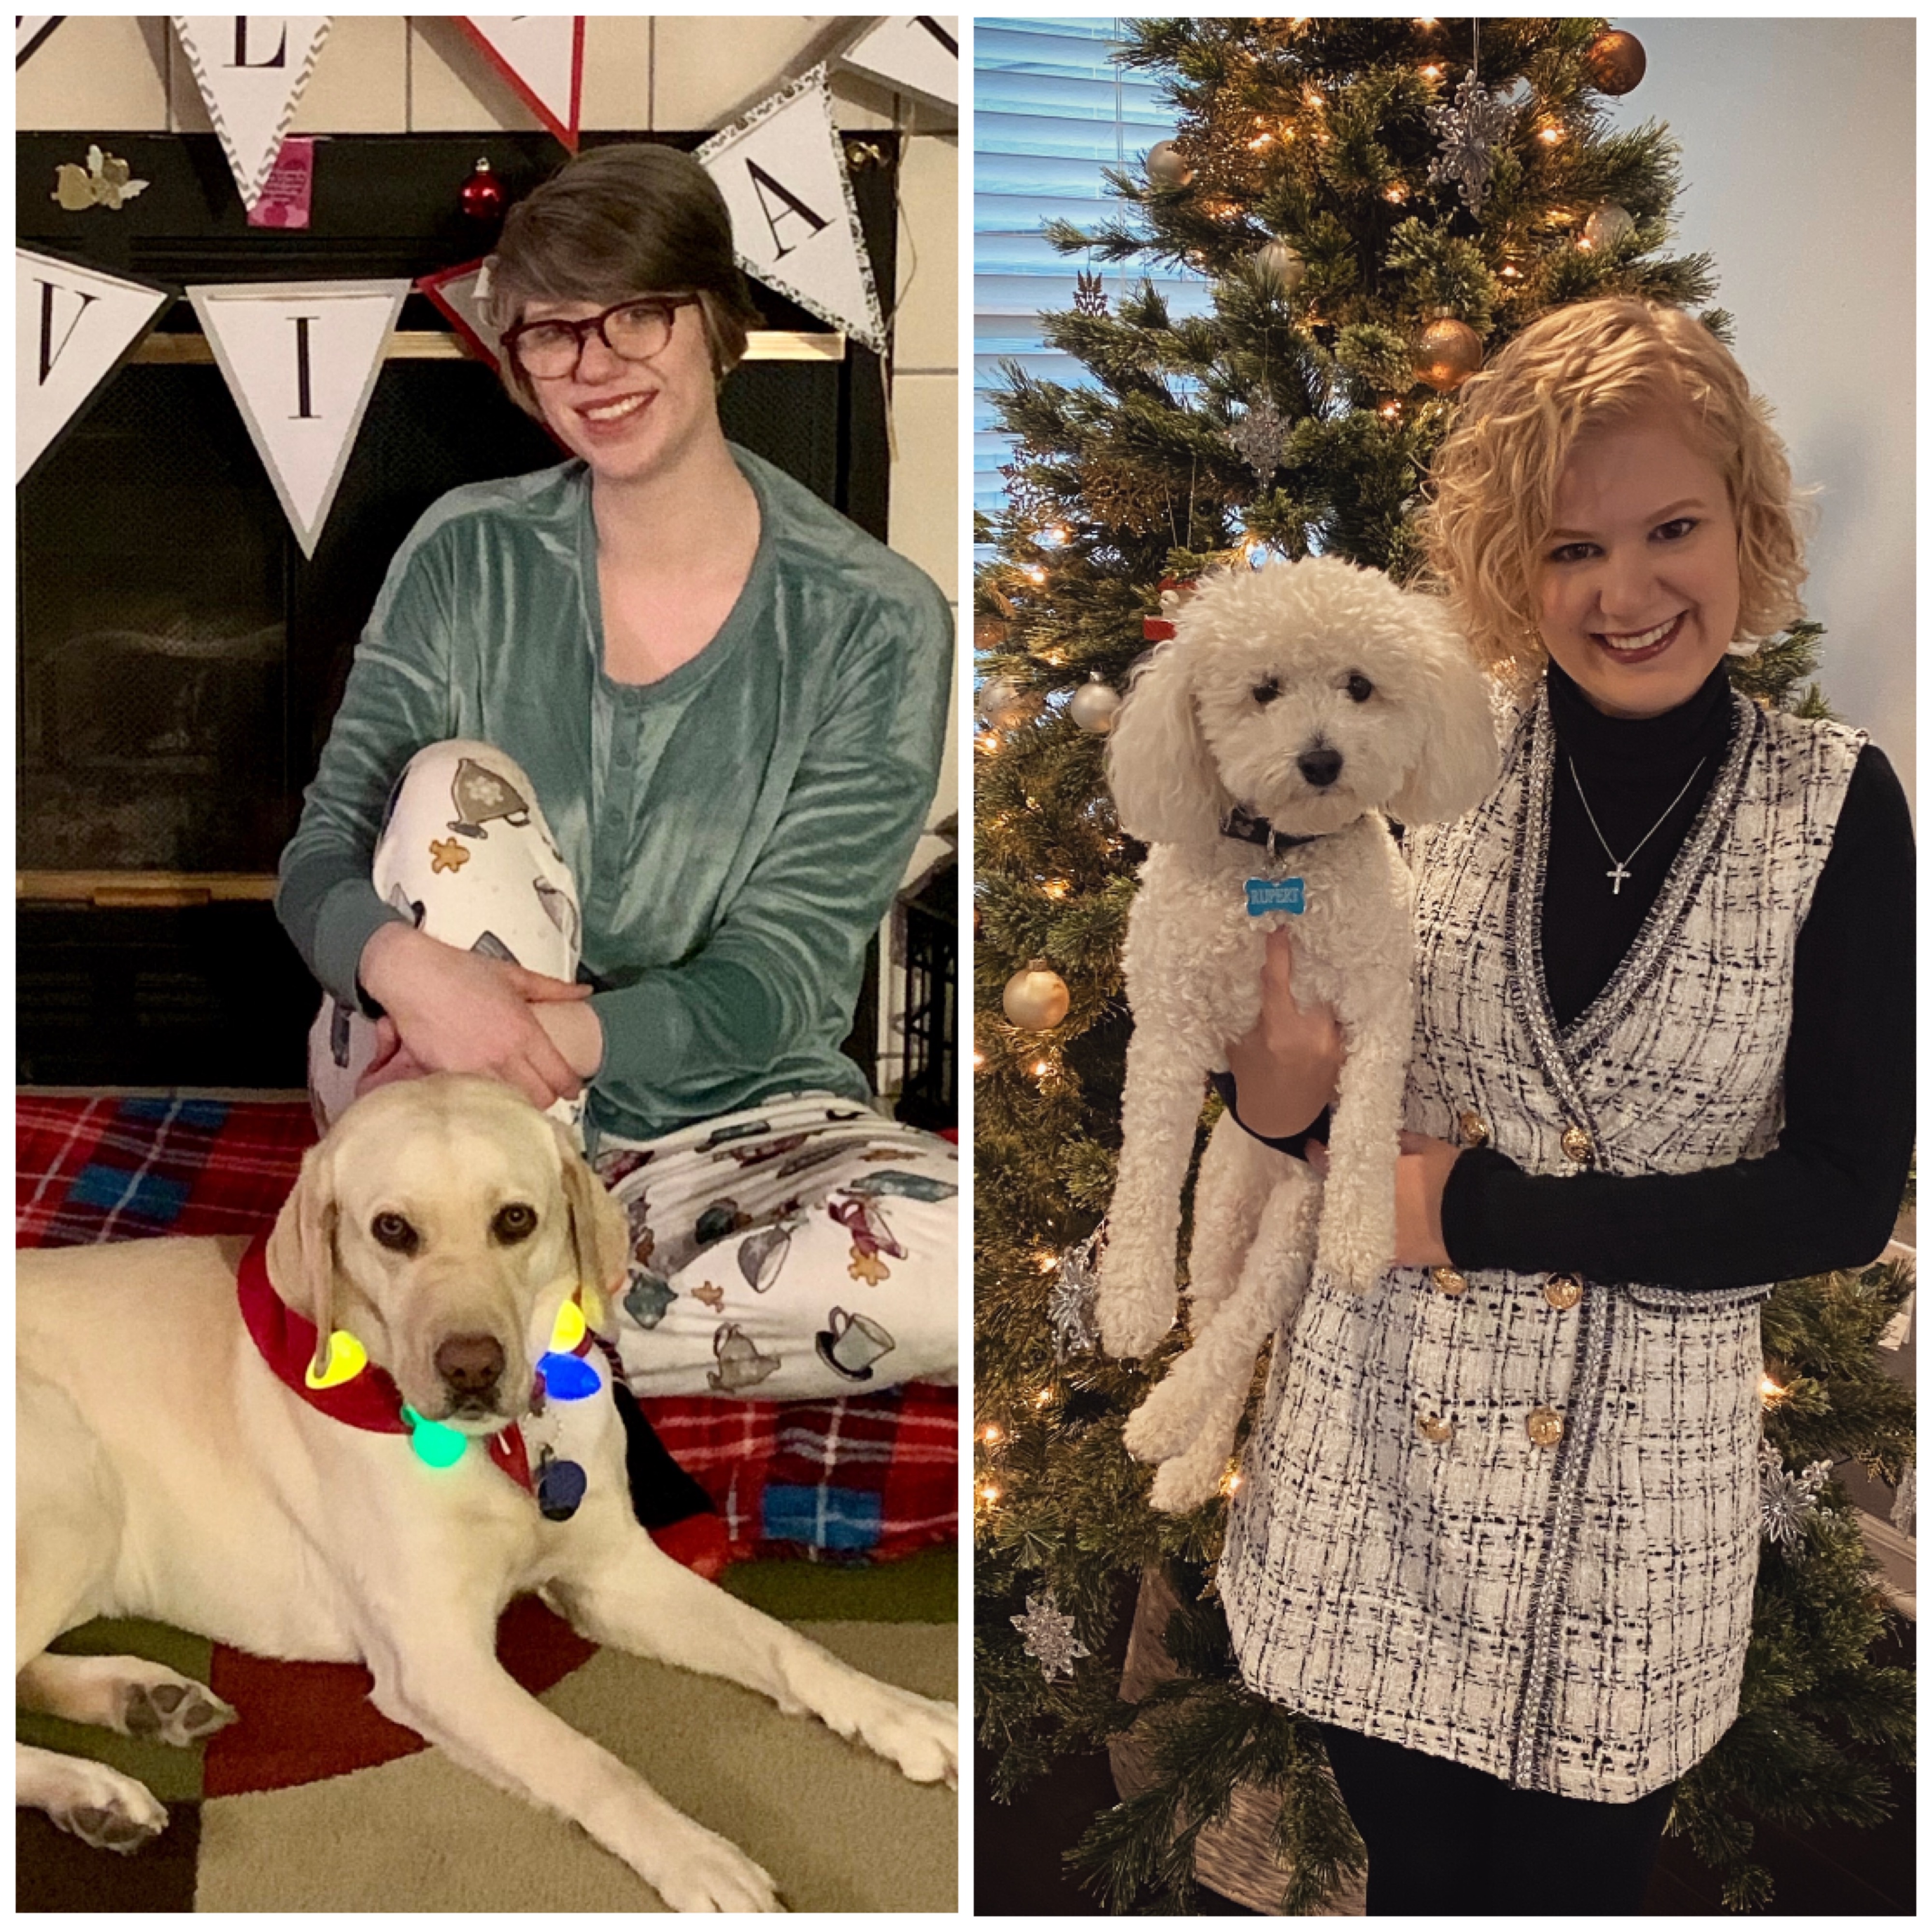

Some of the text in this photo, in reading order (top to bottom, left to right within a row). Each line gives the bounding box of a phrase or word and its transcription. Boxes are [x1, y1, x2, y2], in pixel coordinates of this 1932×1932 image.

[222, 16, 287, 68] L
[745, 157, 837, 262] A
[33, 277, 100, 386] V
[286, 316, 322, 419] I
[1250, 887, 1299, 904] RUPERT
